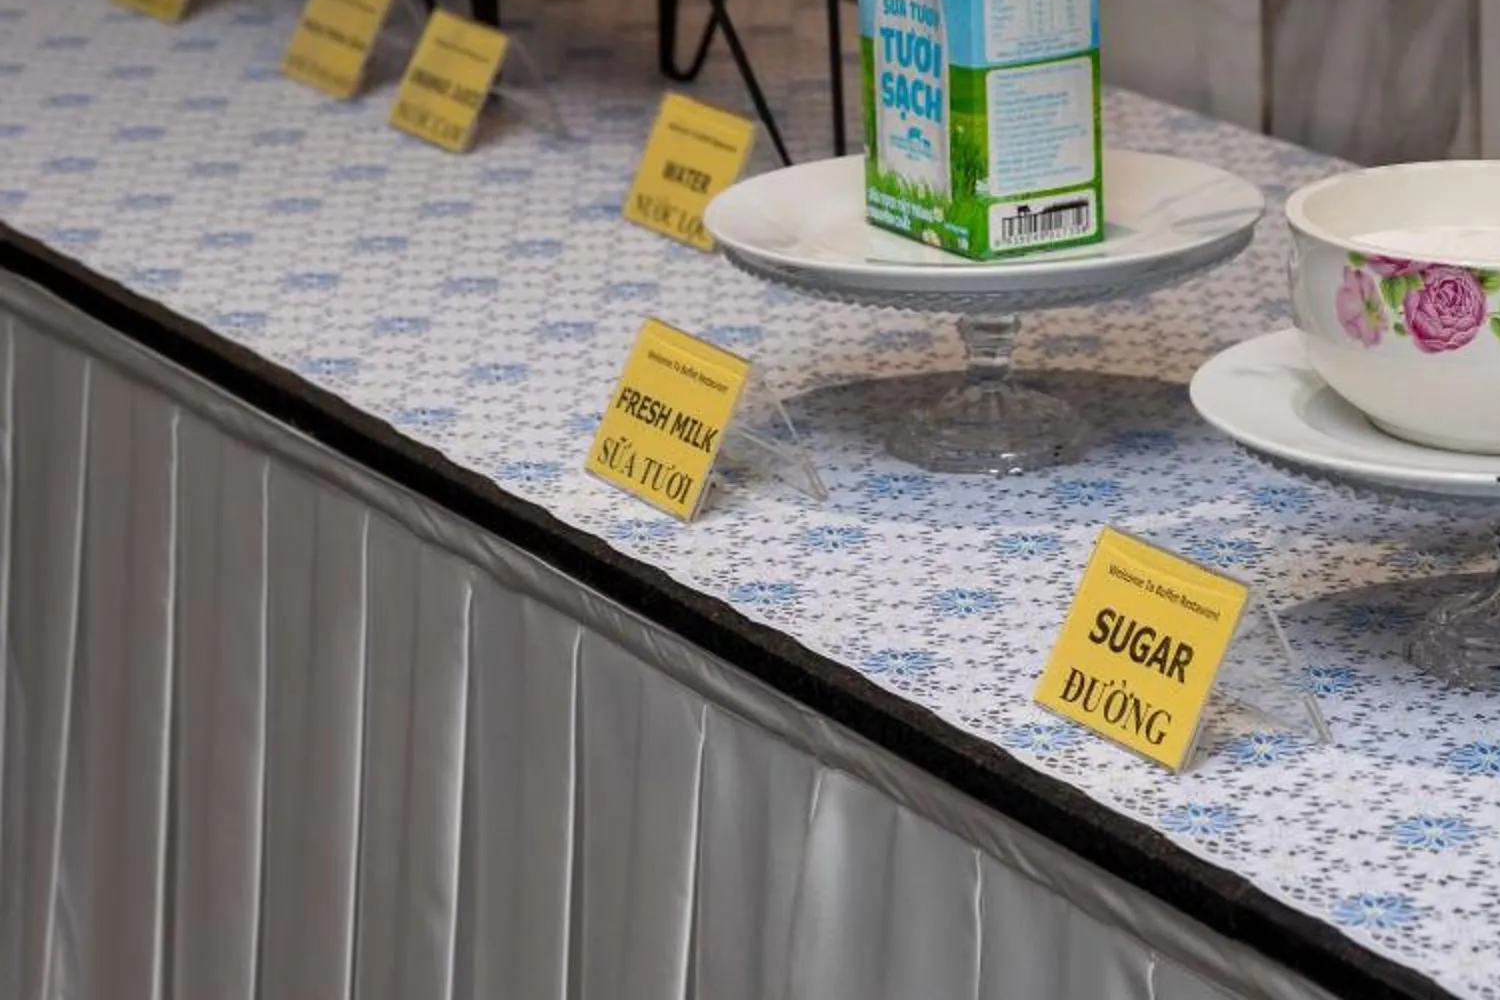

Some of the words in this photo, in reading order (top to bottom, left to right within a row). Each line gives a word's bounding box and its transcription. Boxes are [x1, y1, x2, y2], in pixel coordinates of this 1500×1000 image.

[880, 26, 942, 80] TƯƠI
[881, 71, 943, 123] SẠCH
[616, 387, 673, 431] FRESH
[670, 412, 719, 453] MILK
[597, 436, 636, 478] SỮA
[640, 455, 693, 505] TƯƠI
[1088, 608, 1194, 683] SUGAR
